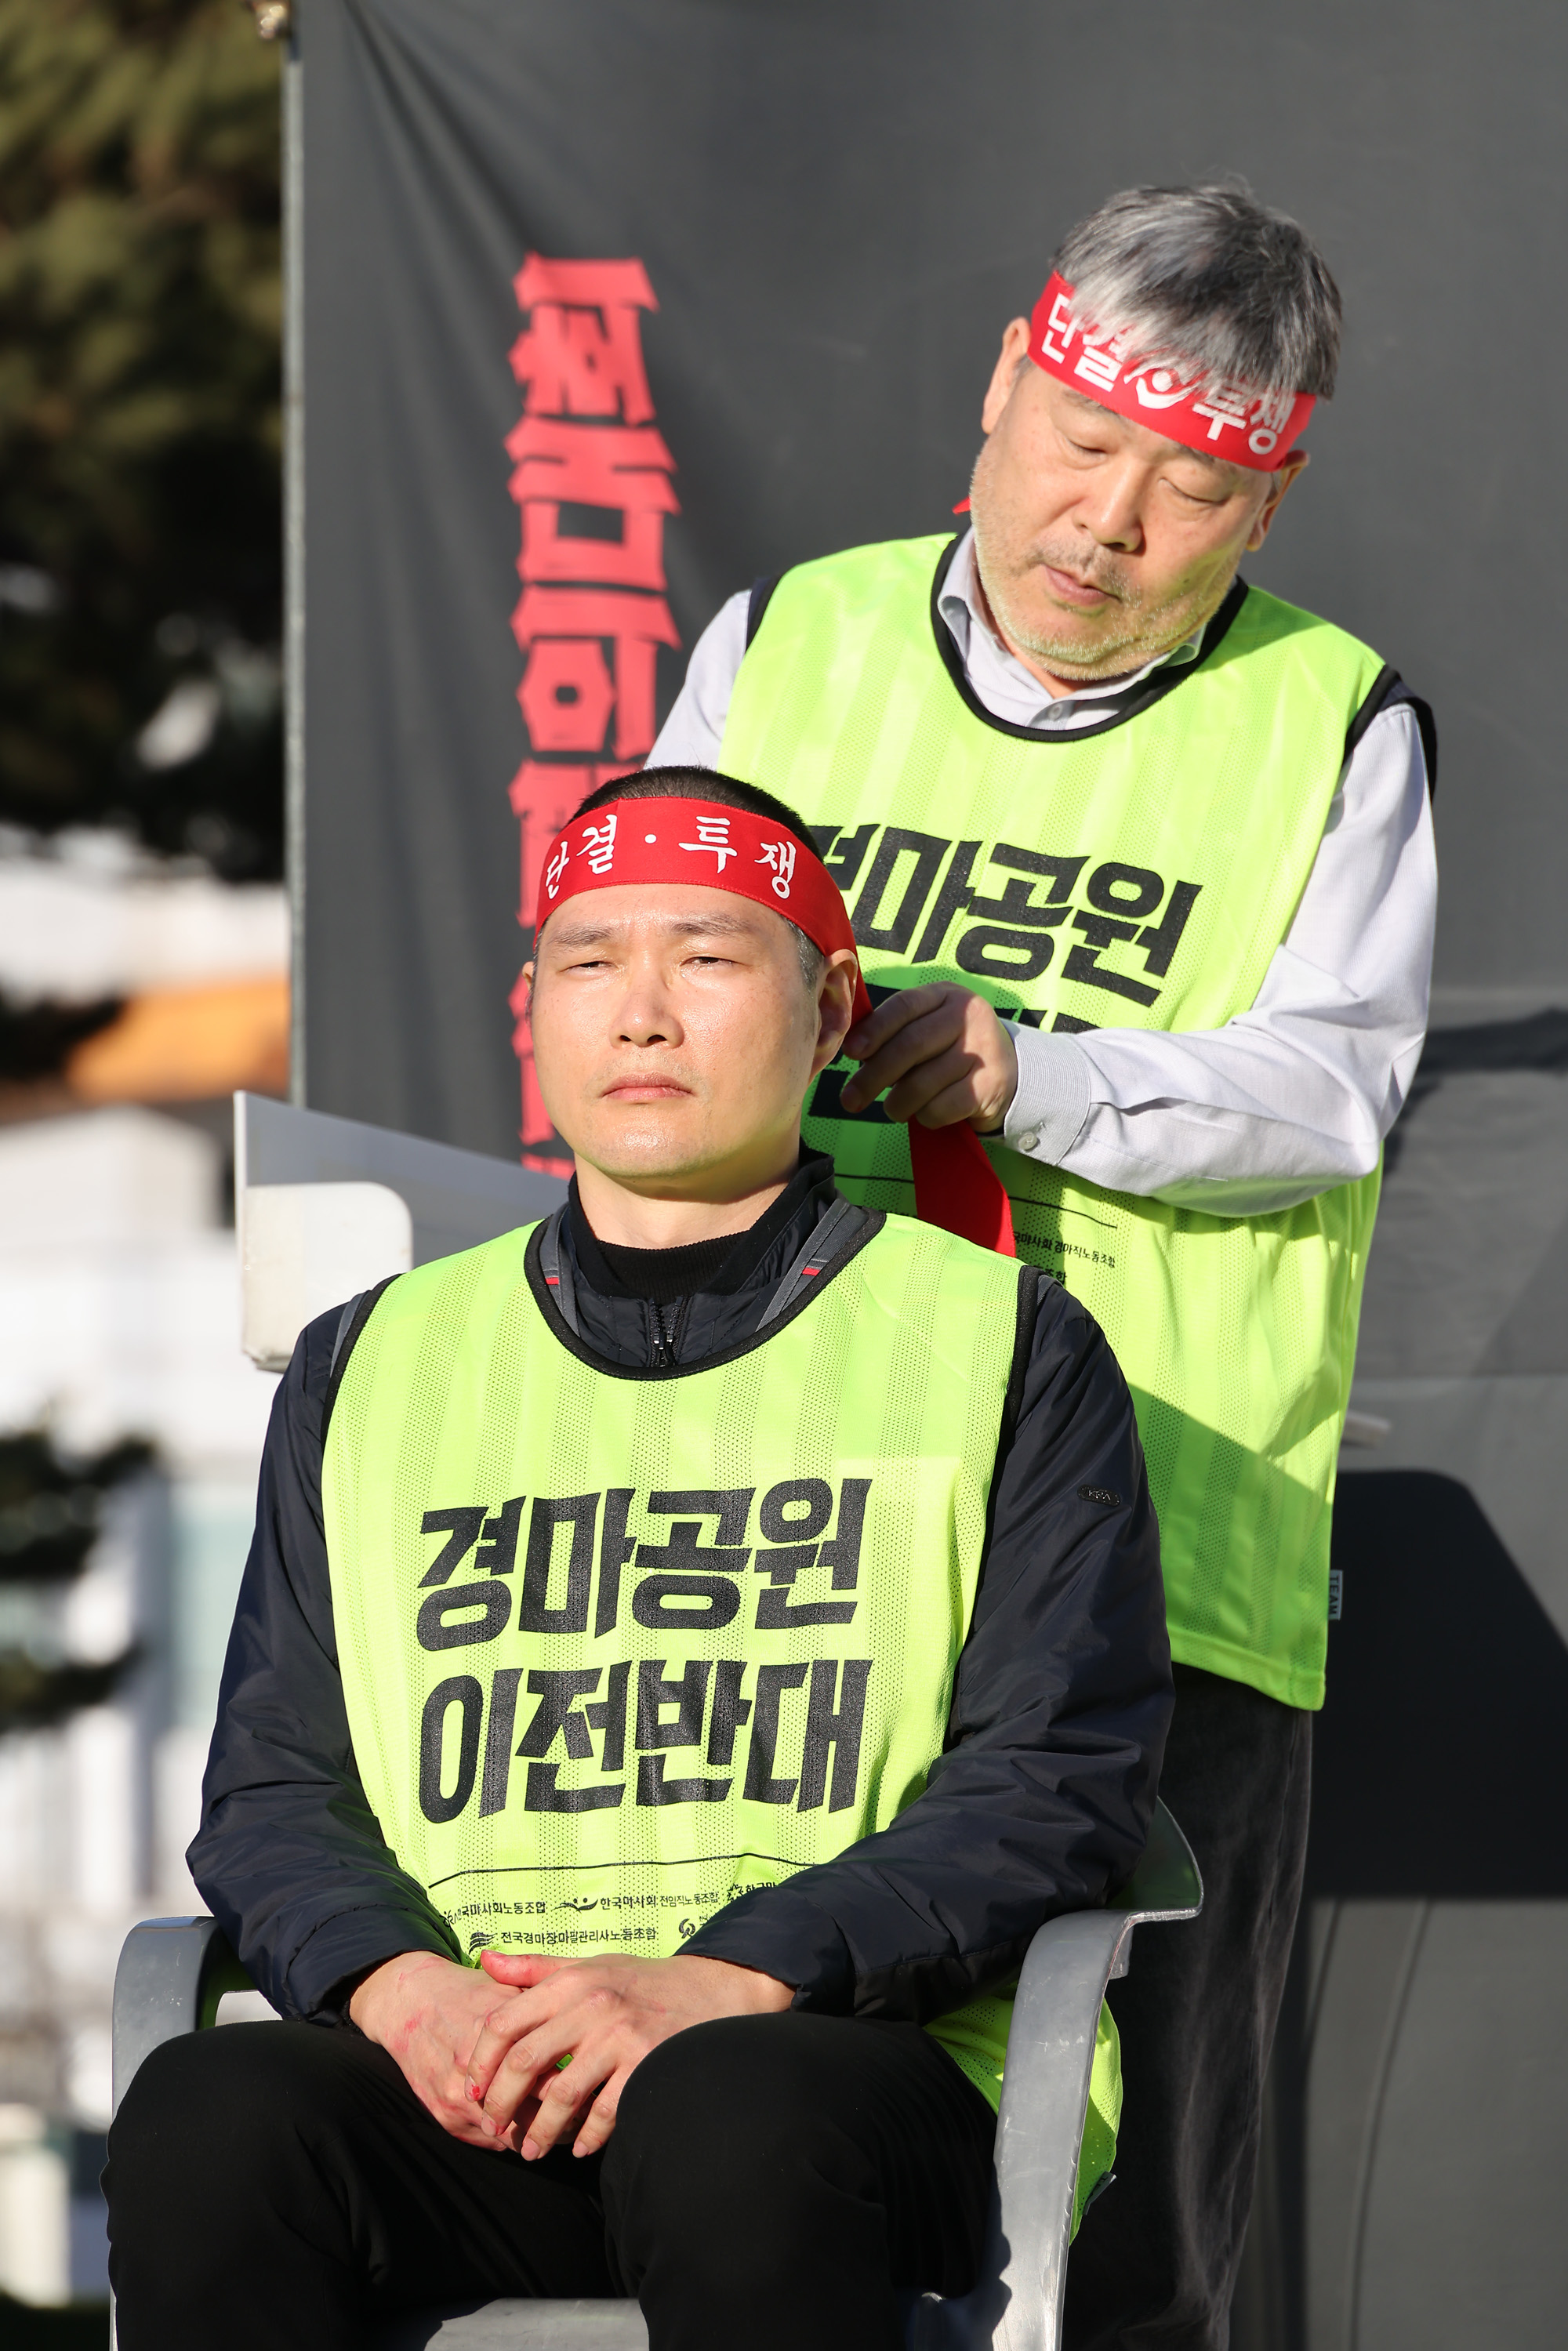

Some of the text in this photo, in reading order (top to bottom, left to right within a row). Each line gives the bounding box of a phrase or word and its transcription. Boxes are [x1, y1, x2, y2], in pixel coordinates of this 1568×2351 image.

[416, 1478, 873, 1652] 경마공원
[1329, 1575, 1339, 1614] TEAM
[419, 1660, 873, 1823] 이전반대
